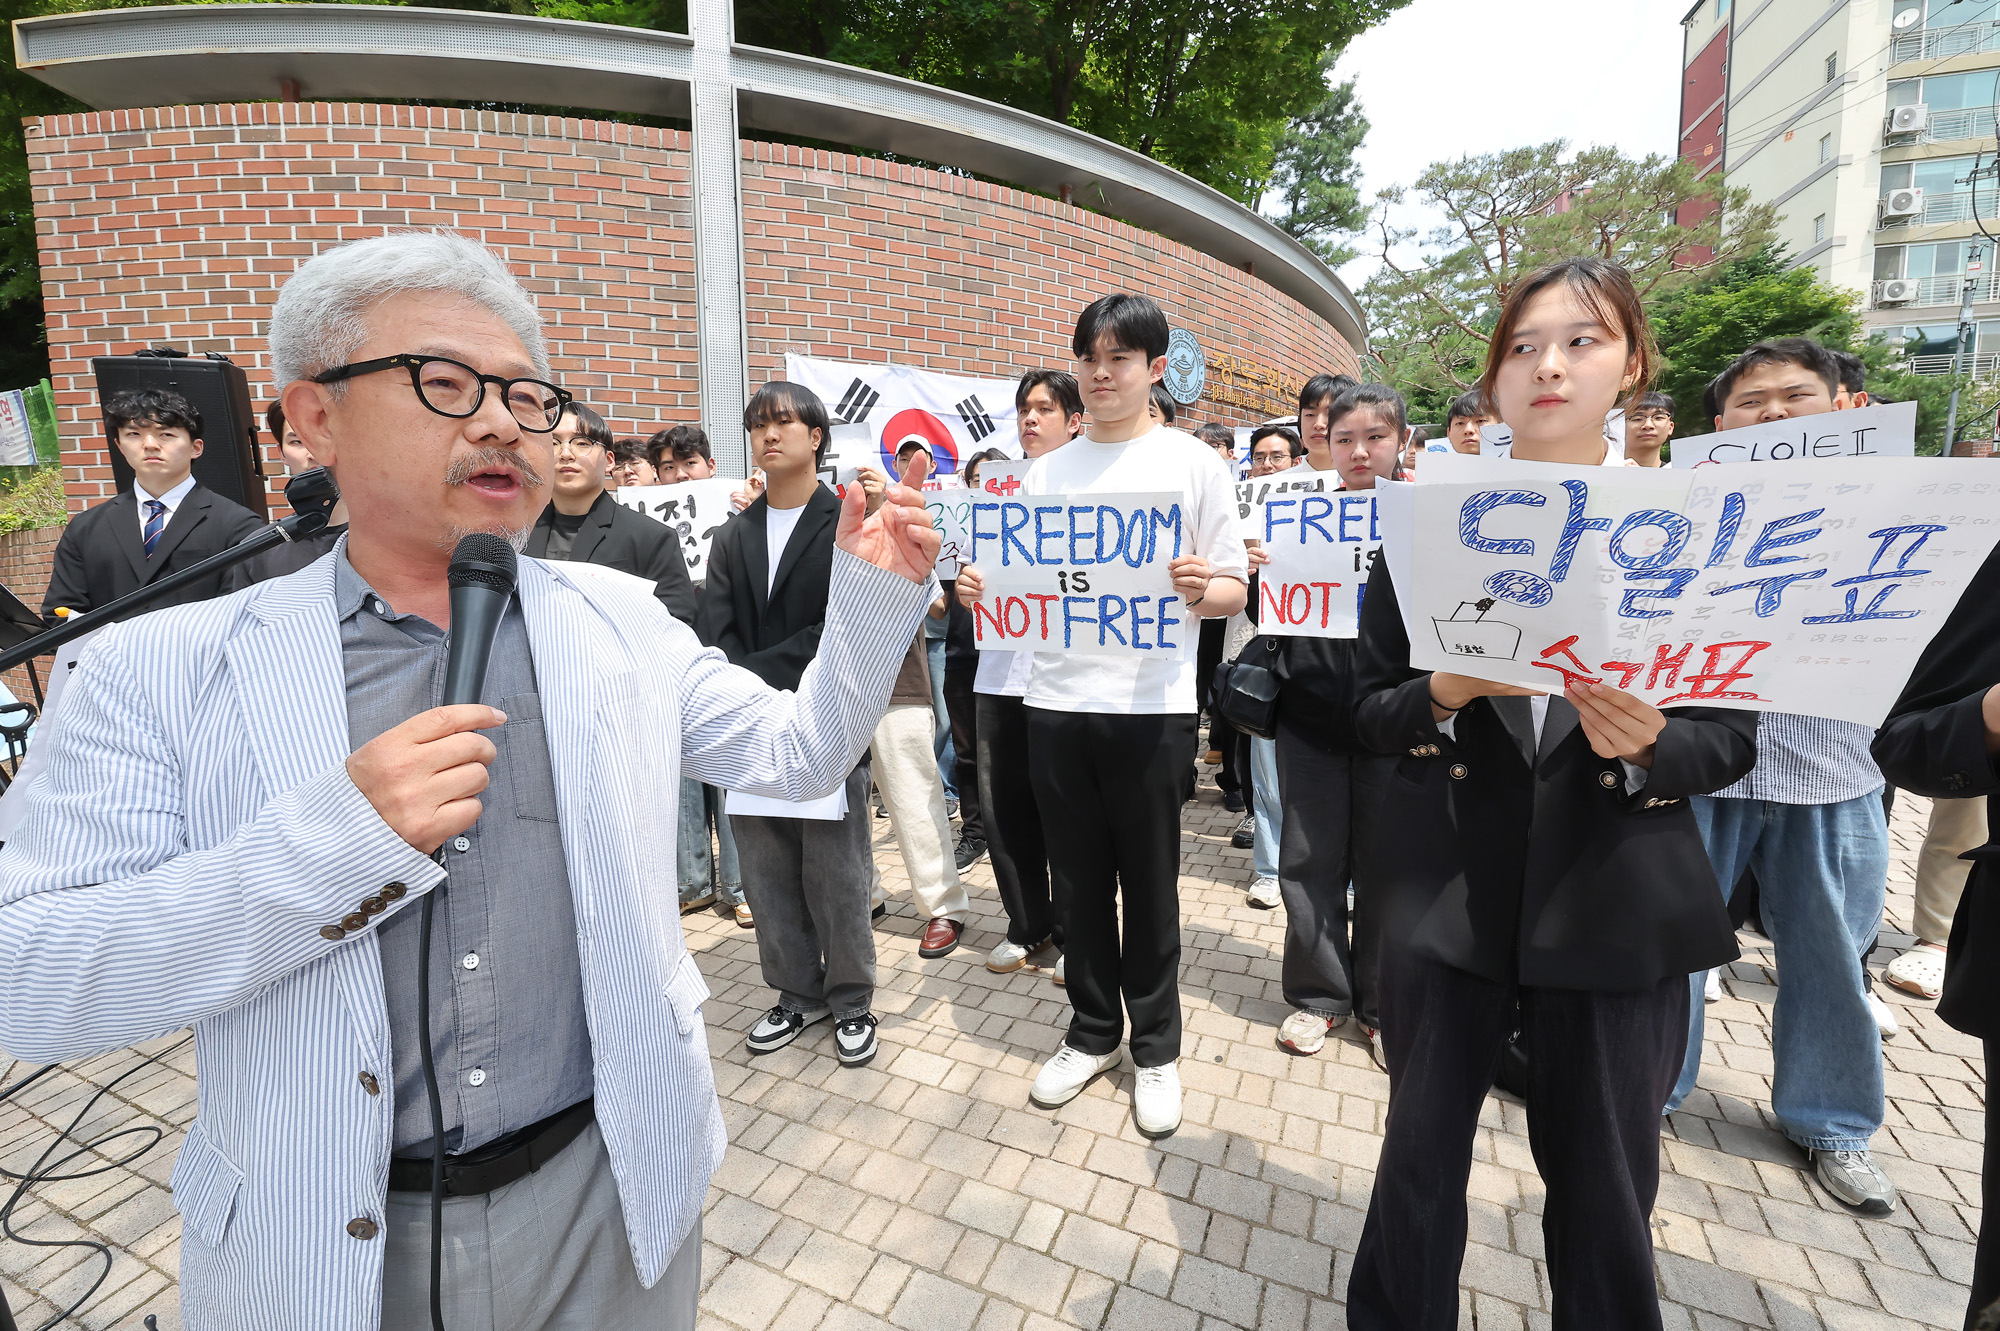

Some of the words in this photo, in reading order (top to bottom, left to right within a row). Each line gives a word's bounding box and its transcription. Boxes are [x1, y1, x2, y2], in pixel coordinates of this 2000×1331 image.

[1213, 352, 1304, 406] 장로회신
[971, 502, 1182, 568] FREEDOM
[1458, 479, 1949, 626] 당일투표
[1059, 570, 1090, 593] is
[1261, 581, 1342, 629] NOT
[972, 593, 1060, 642] NOT
[1063, 595, 1179, 650] FREE
[1530, 634, 1774, 707] 수개표
